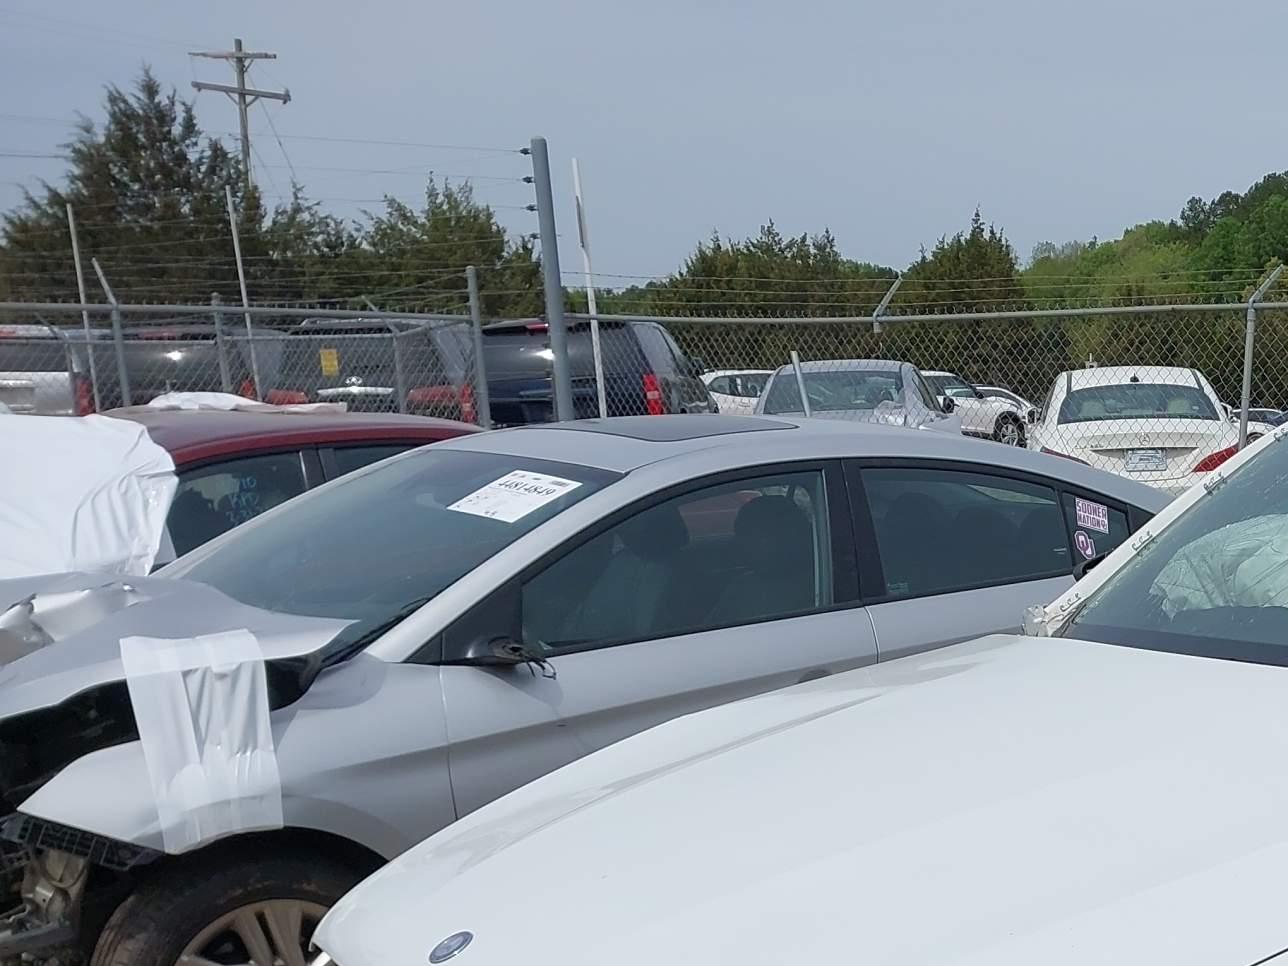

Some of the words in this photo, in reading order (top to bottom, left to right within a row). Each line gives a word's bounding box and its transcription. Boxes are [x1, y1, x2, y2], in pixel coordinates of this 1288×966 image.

[498, 479, 557, 497] 44814849
[1076, 500, 1107, 521] SOONER
[1077, 512, 1102, 529] NATION
